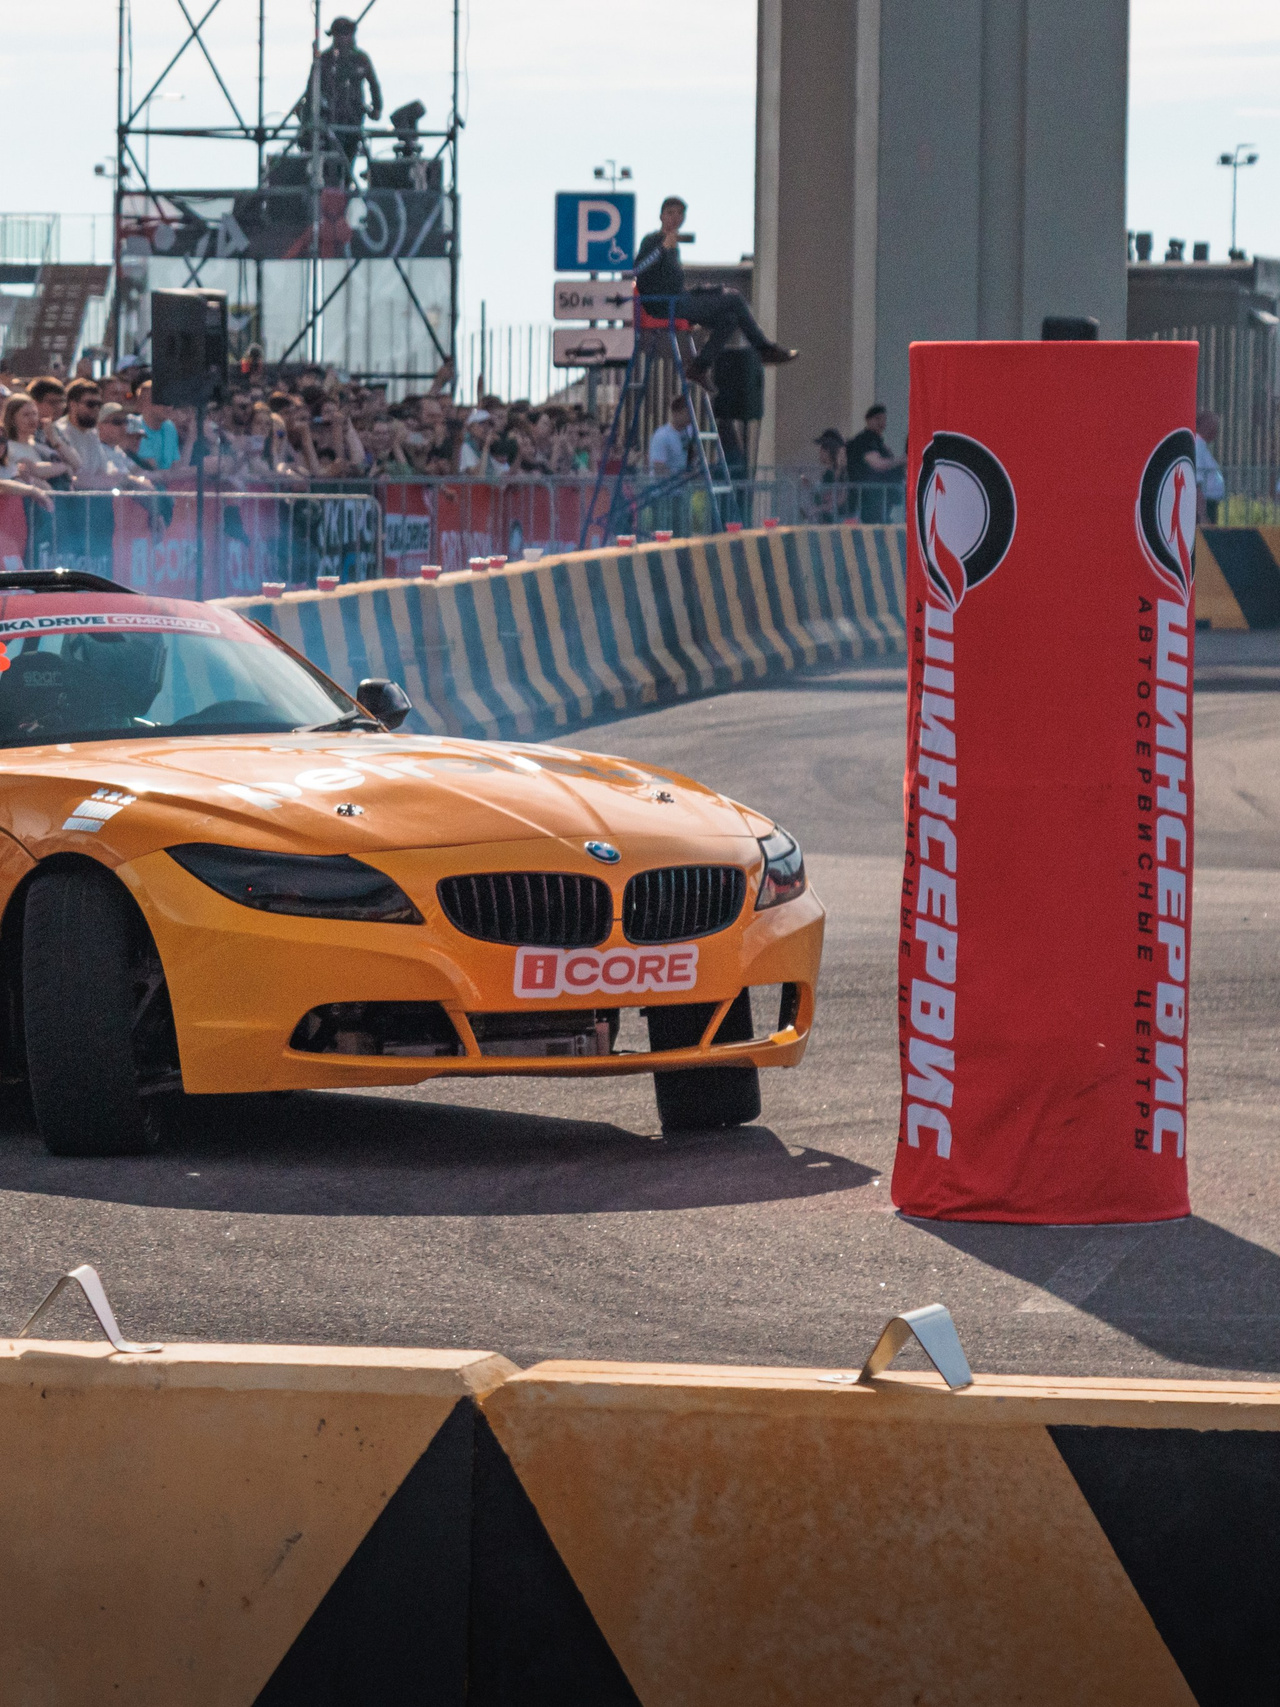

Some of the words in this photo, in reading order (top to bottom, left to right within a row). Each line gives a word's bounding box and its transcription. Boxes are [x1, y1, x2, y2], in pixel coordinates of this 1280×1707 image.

[558, 291, 580, 308] 50
[577, 201, 621, 264] P
[38, 615, 106, 629] DRIVE
[1135, 596, 1154, 962] АВТОСЕРВИСНЫЕ
[907, 600, 958, 1160] ШИНСЕРВИС
[1151, 598, 1188, 1158] ШИНСЕРВИС
[1134, 989, 1153, 1150] ЦЕНТРЫ
